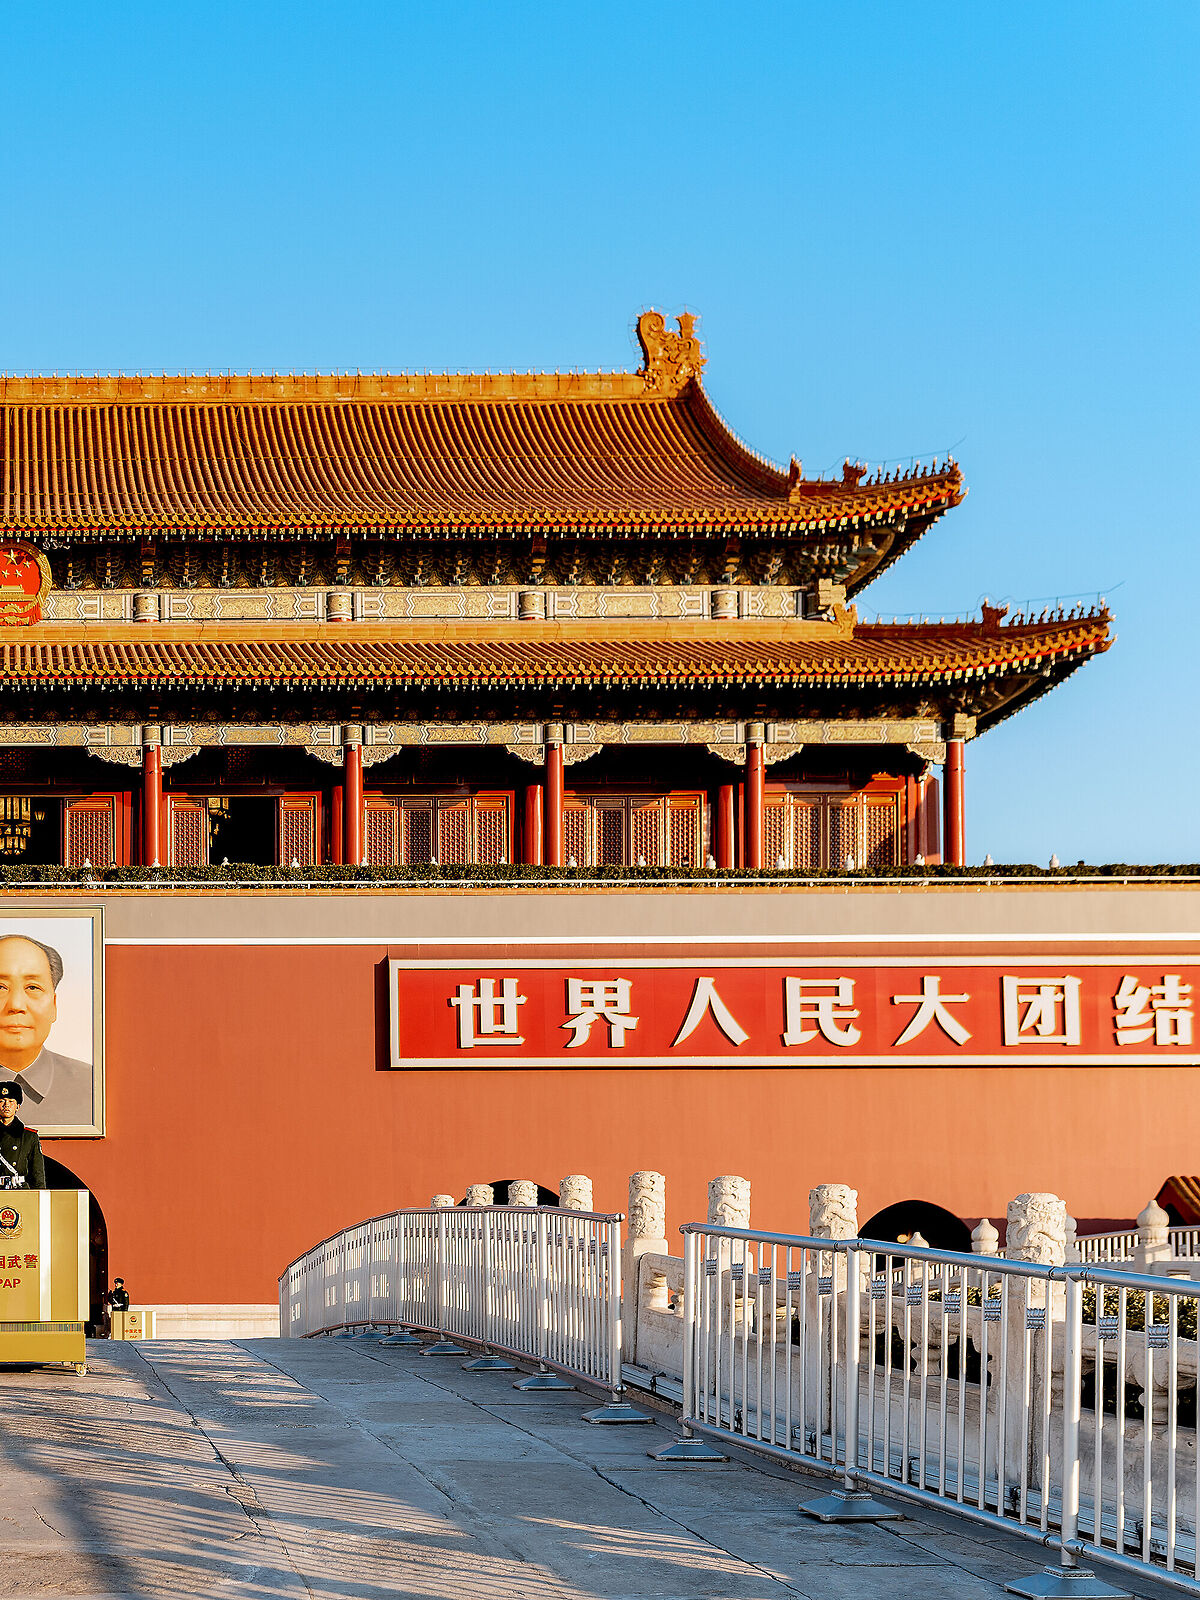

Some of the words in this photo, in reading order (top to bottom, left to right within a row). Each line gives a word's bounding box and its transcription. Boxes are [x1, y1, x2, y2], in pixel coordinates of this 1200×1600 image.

[448, 973, 1195, 1048] 世界人民大团结
